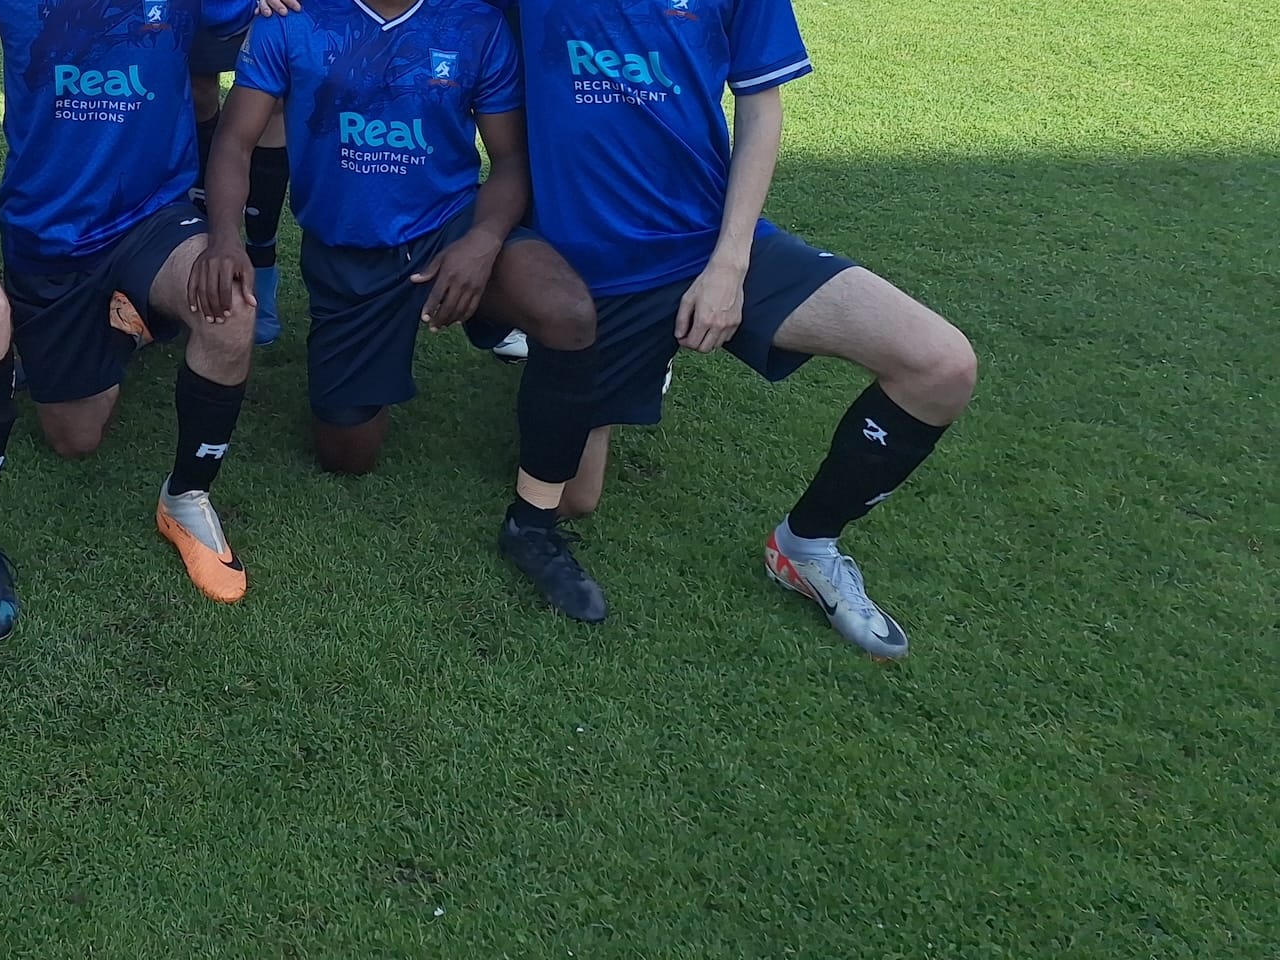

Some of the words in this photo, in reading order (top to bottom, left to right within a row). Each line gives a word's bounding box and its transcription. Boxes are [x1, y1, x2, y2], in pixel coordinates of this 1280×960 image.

[567, 39, 681, 95] Real.
[55, 64, 156, 101] Real.
[574, 81, 668, 102] RECRUIMENT
[55, 99, 143, 112] RECRUITMENT
[55, 110, 125, 123] SOLUTIONS
[339, 111, 434, 155] Real.
[341, 148, 426, 166] RECRUITMENT
[340, 159, 407, 175] SOLUTIONS
